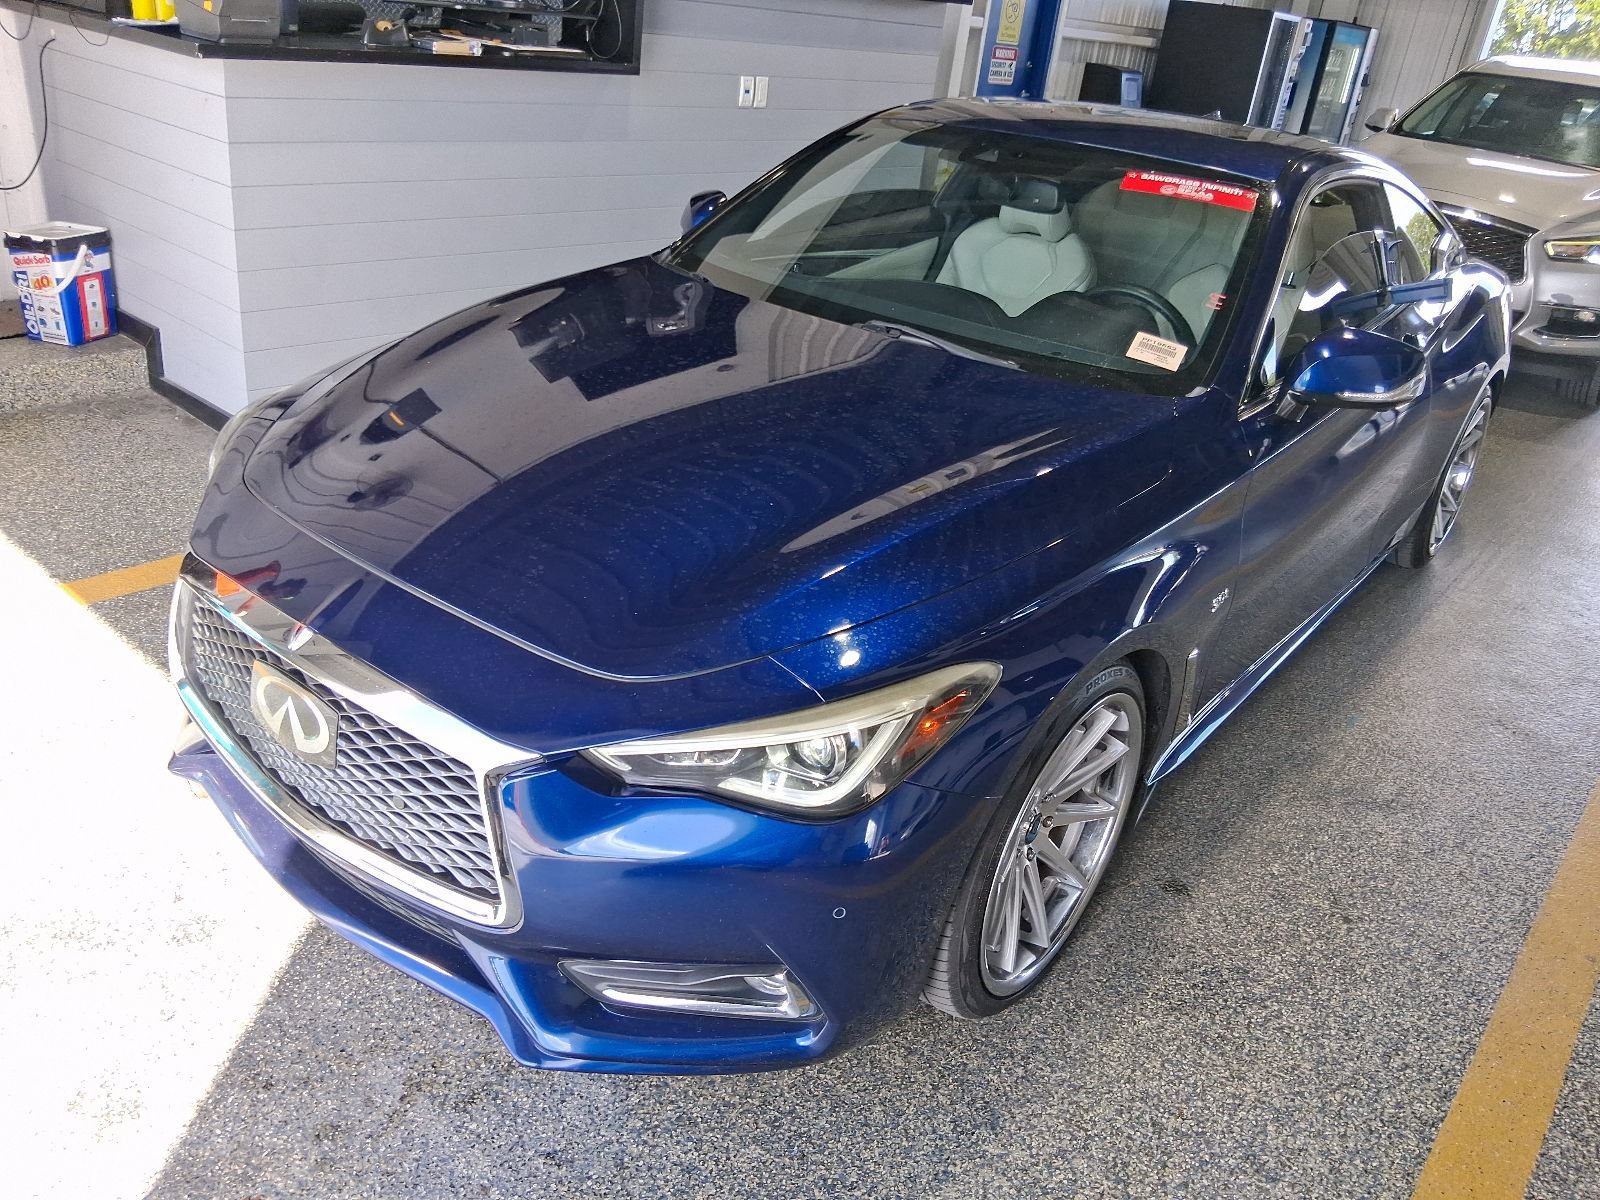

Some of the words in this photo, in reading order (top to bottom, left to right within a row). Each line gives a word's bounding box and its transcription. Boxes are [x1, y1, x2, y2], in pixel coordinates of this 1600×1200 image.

[13, 256, 34, 266] Quick
[34, 255, 51, 265] Sorb
[1085, 668, 1124, 695] PROXES
